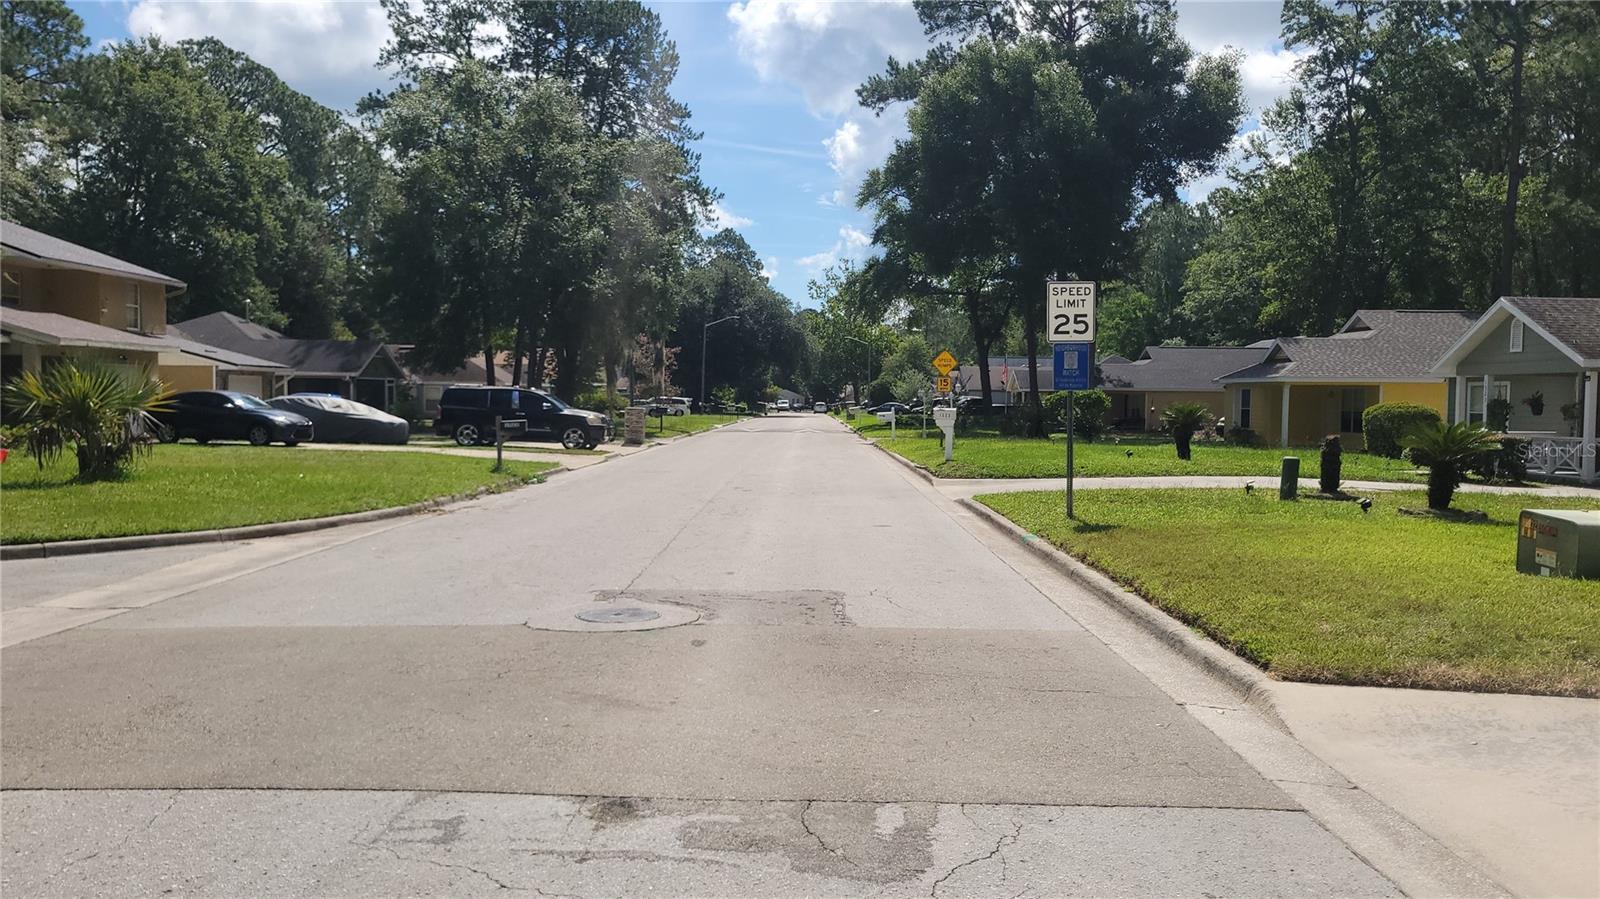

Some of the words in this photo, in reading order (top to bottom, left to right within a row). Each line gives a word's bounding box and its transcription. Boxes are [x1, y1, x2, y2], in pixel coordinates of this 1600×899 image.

[1052, 286, 1092, 296] SPEED
[1056, 298, 1087, 309] LIMIT
[1053, 313, 1090, 335] 25
[939, 378, 949, 387] 15
